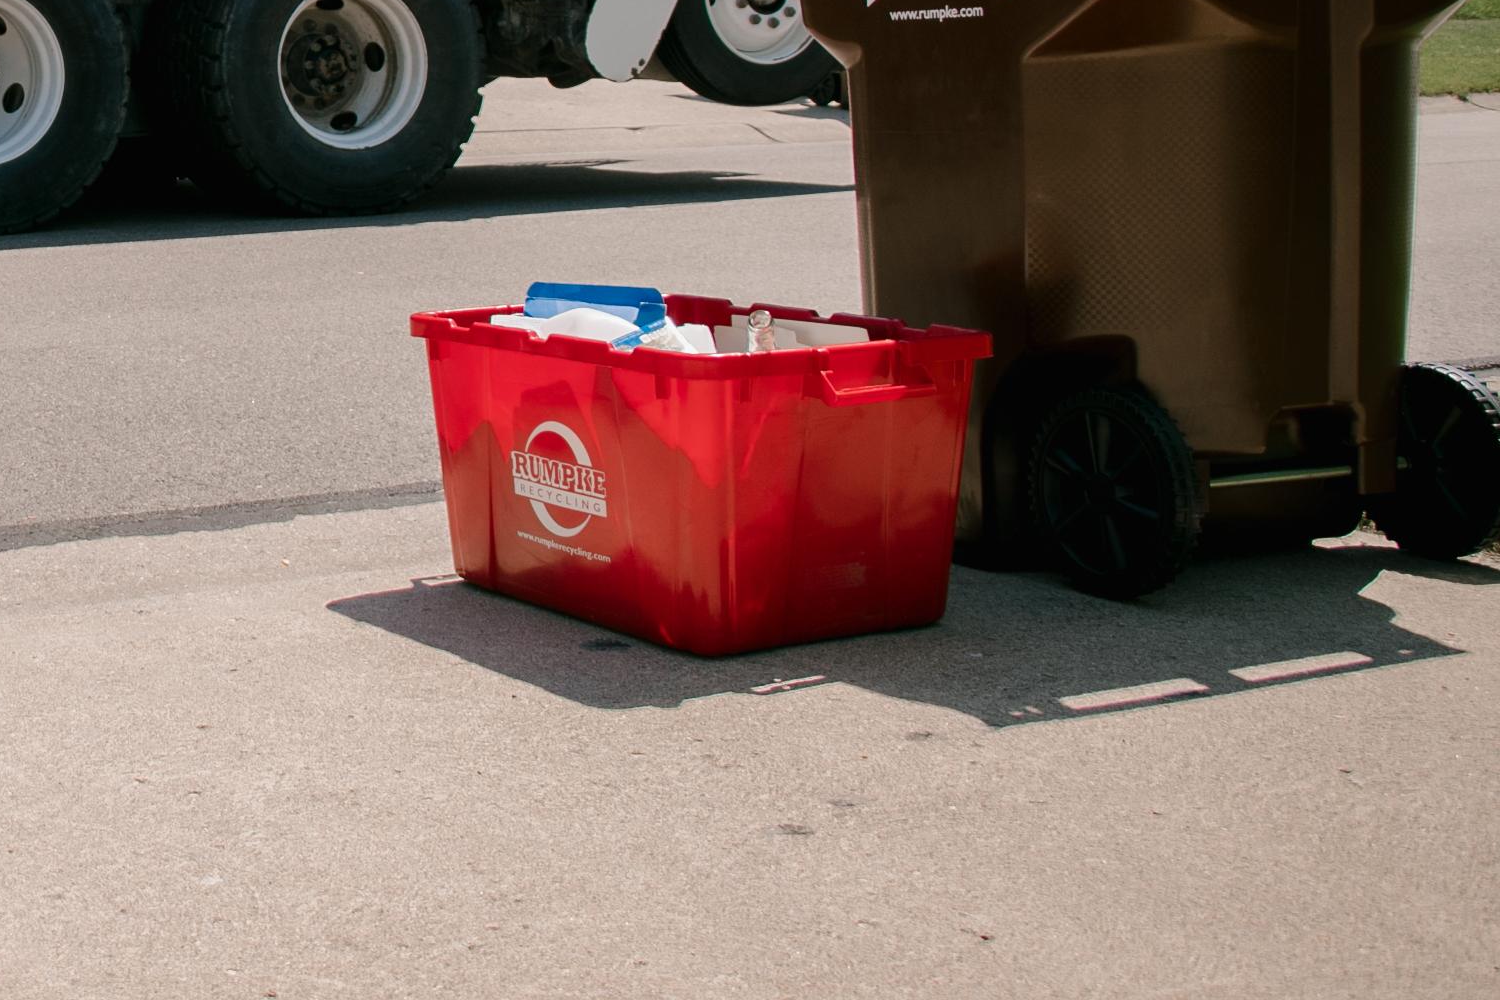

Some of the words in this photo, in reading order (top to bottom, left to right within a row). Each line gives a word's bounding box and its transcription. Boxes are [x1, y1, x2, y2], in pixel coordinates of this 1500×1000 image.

[889, 5, 984, 22] www.rumpke.com
[511, 450, 607, 499] RUMPKE
[520, 483, 601, 513] RECYCLING
[517, 530, 611, 563] www.rumpkerecycling.com
